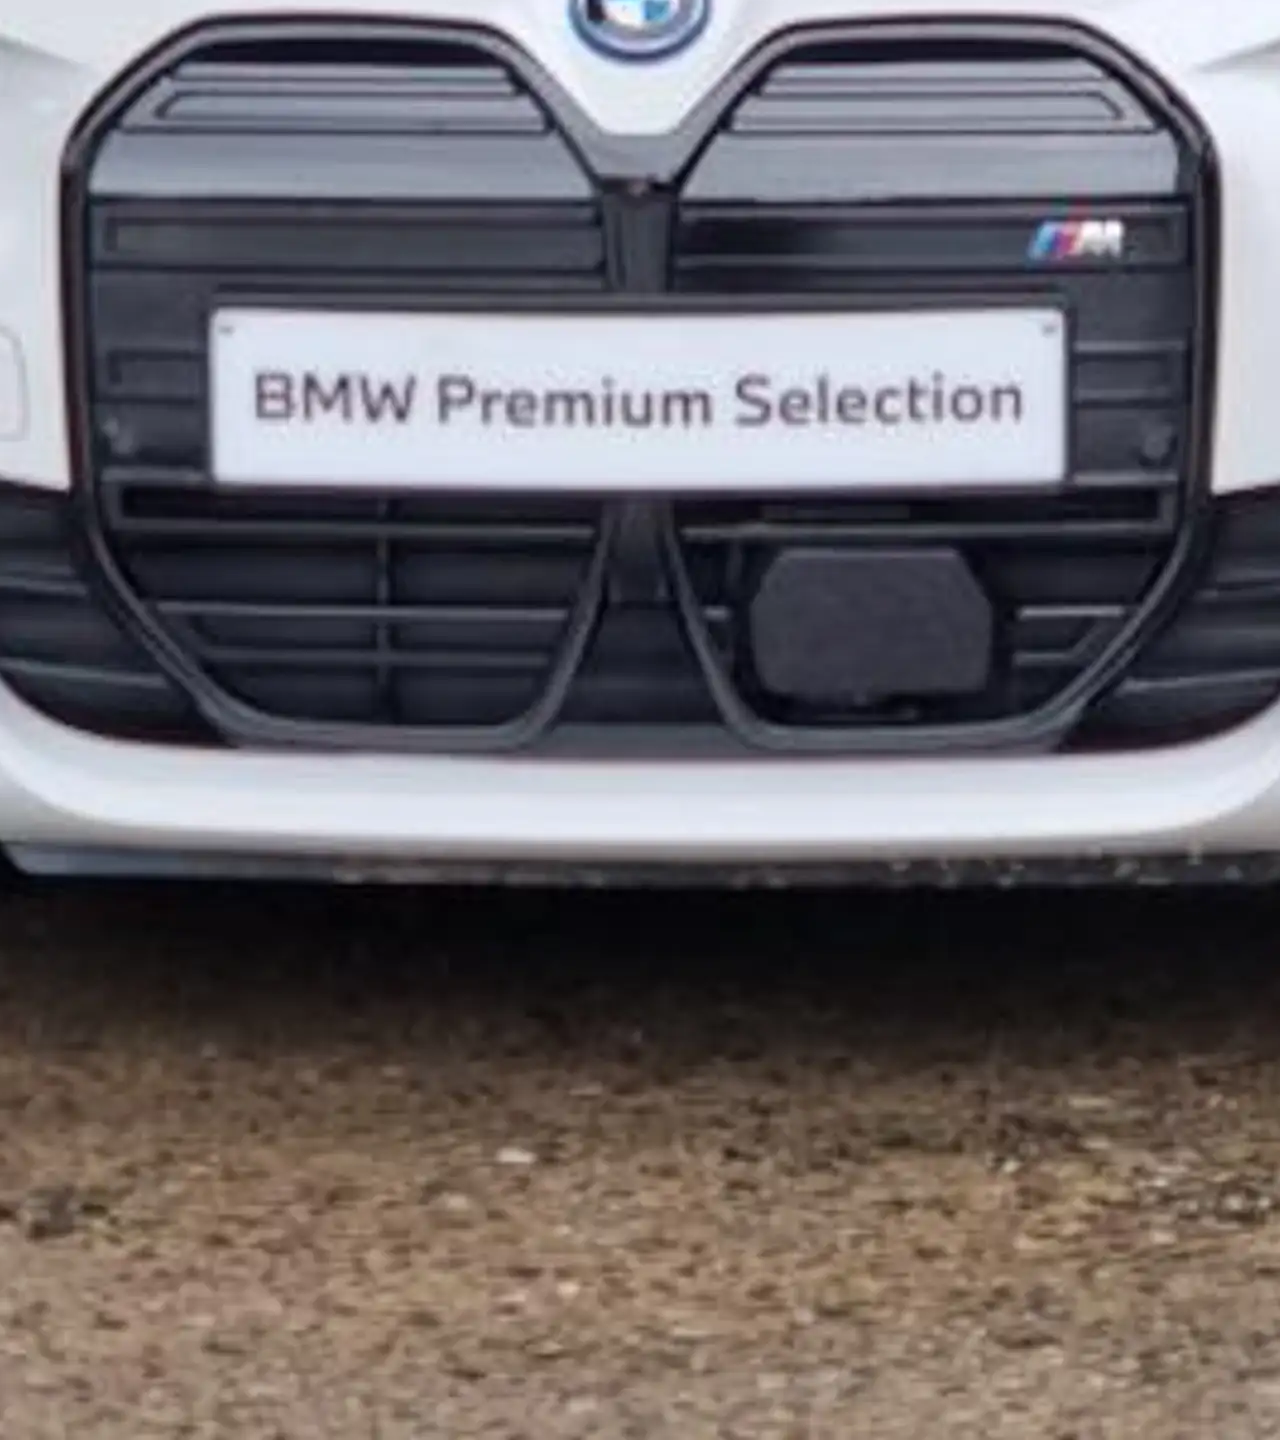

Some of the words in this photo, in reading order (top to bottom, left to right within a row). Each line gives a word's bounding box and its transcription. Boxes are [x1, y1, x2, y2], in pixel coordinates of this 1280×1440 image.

[254, 372, 416, 423] BMW
[437, 374, 711, 428] Premium
[734, 370, 1023, 426] Selection
